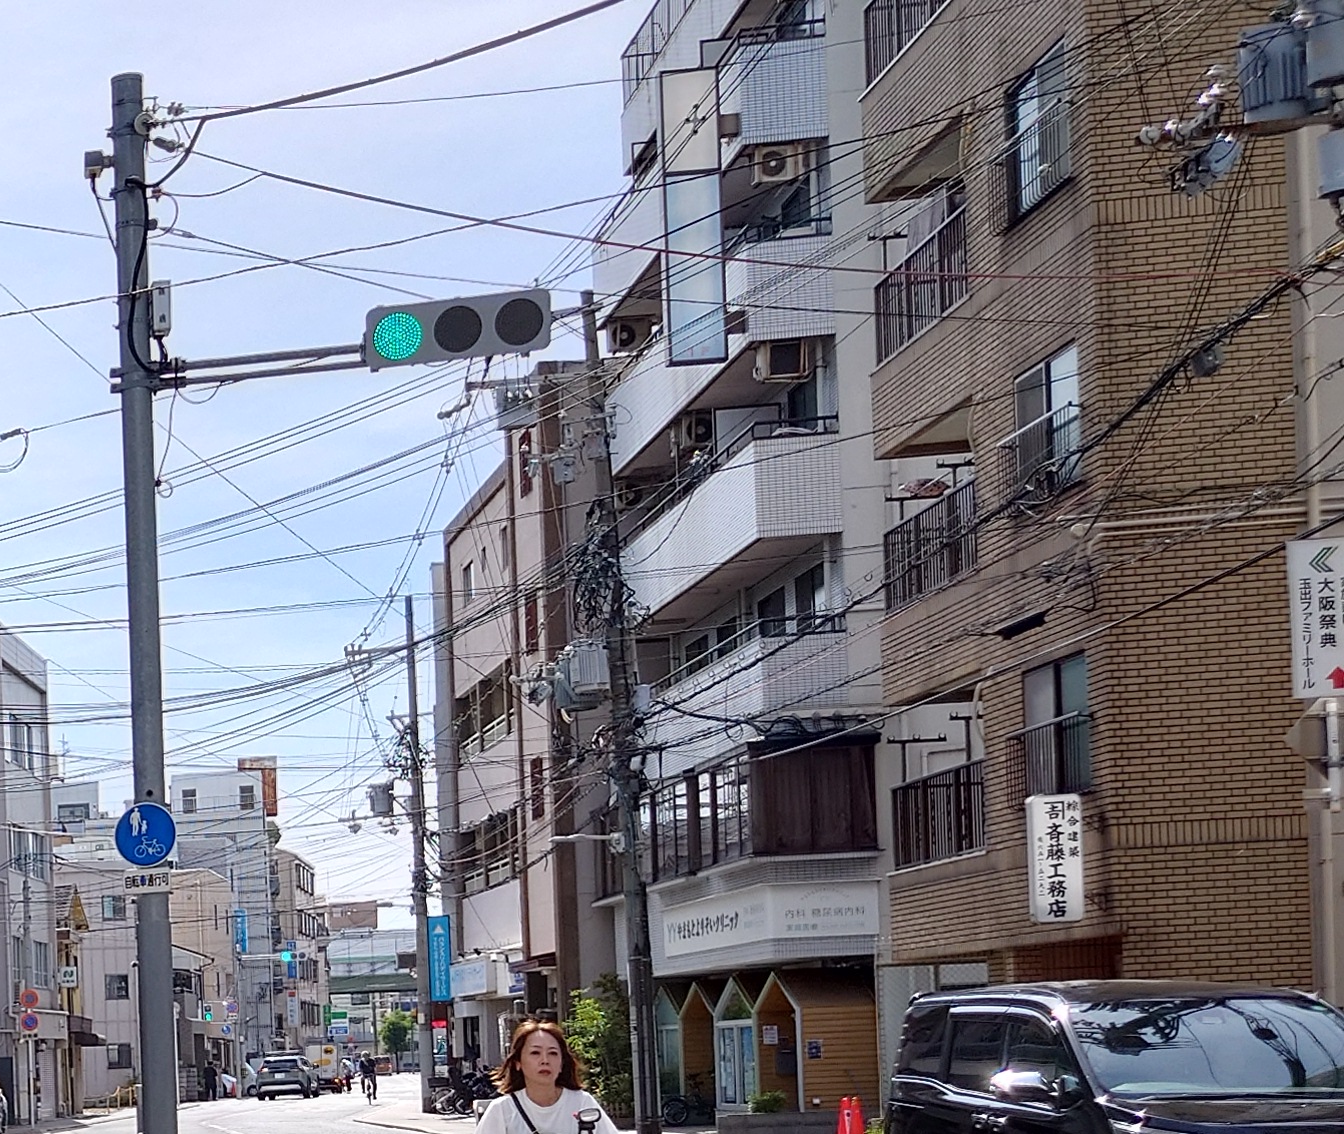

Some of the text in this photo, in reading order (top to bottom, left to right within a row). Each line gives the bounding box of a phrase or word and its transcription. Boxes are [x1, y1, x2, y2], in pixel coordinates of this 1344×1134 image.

[1299, 578, 1315, 690] 玉出ファミリーホール
[1318, 577, 1337, 648] 大阪祭典
